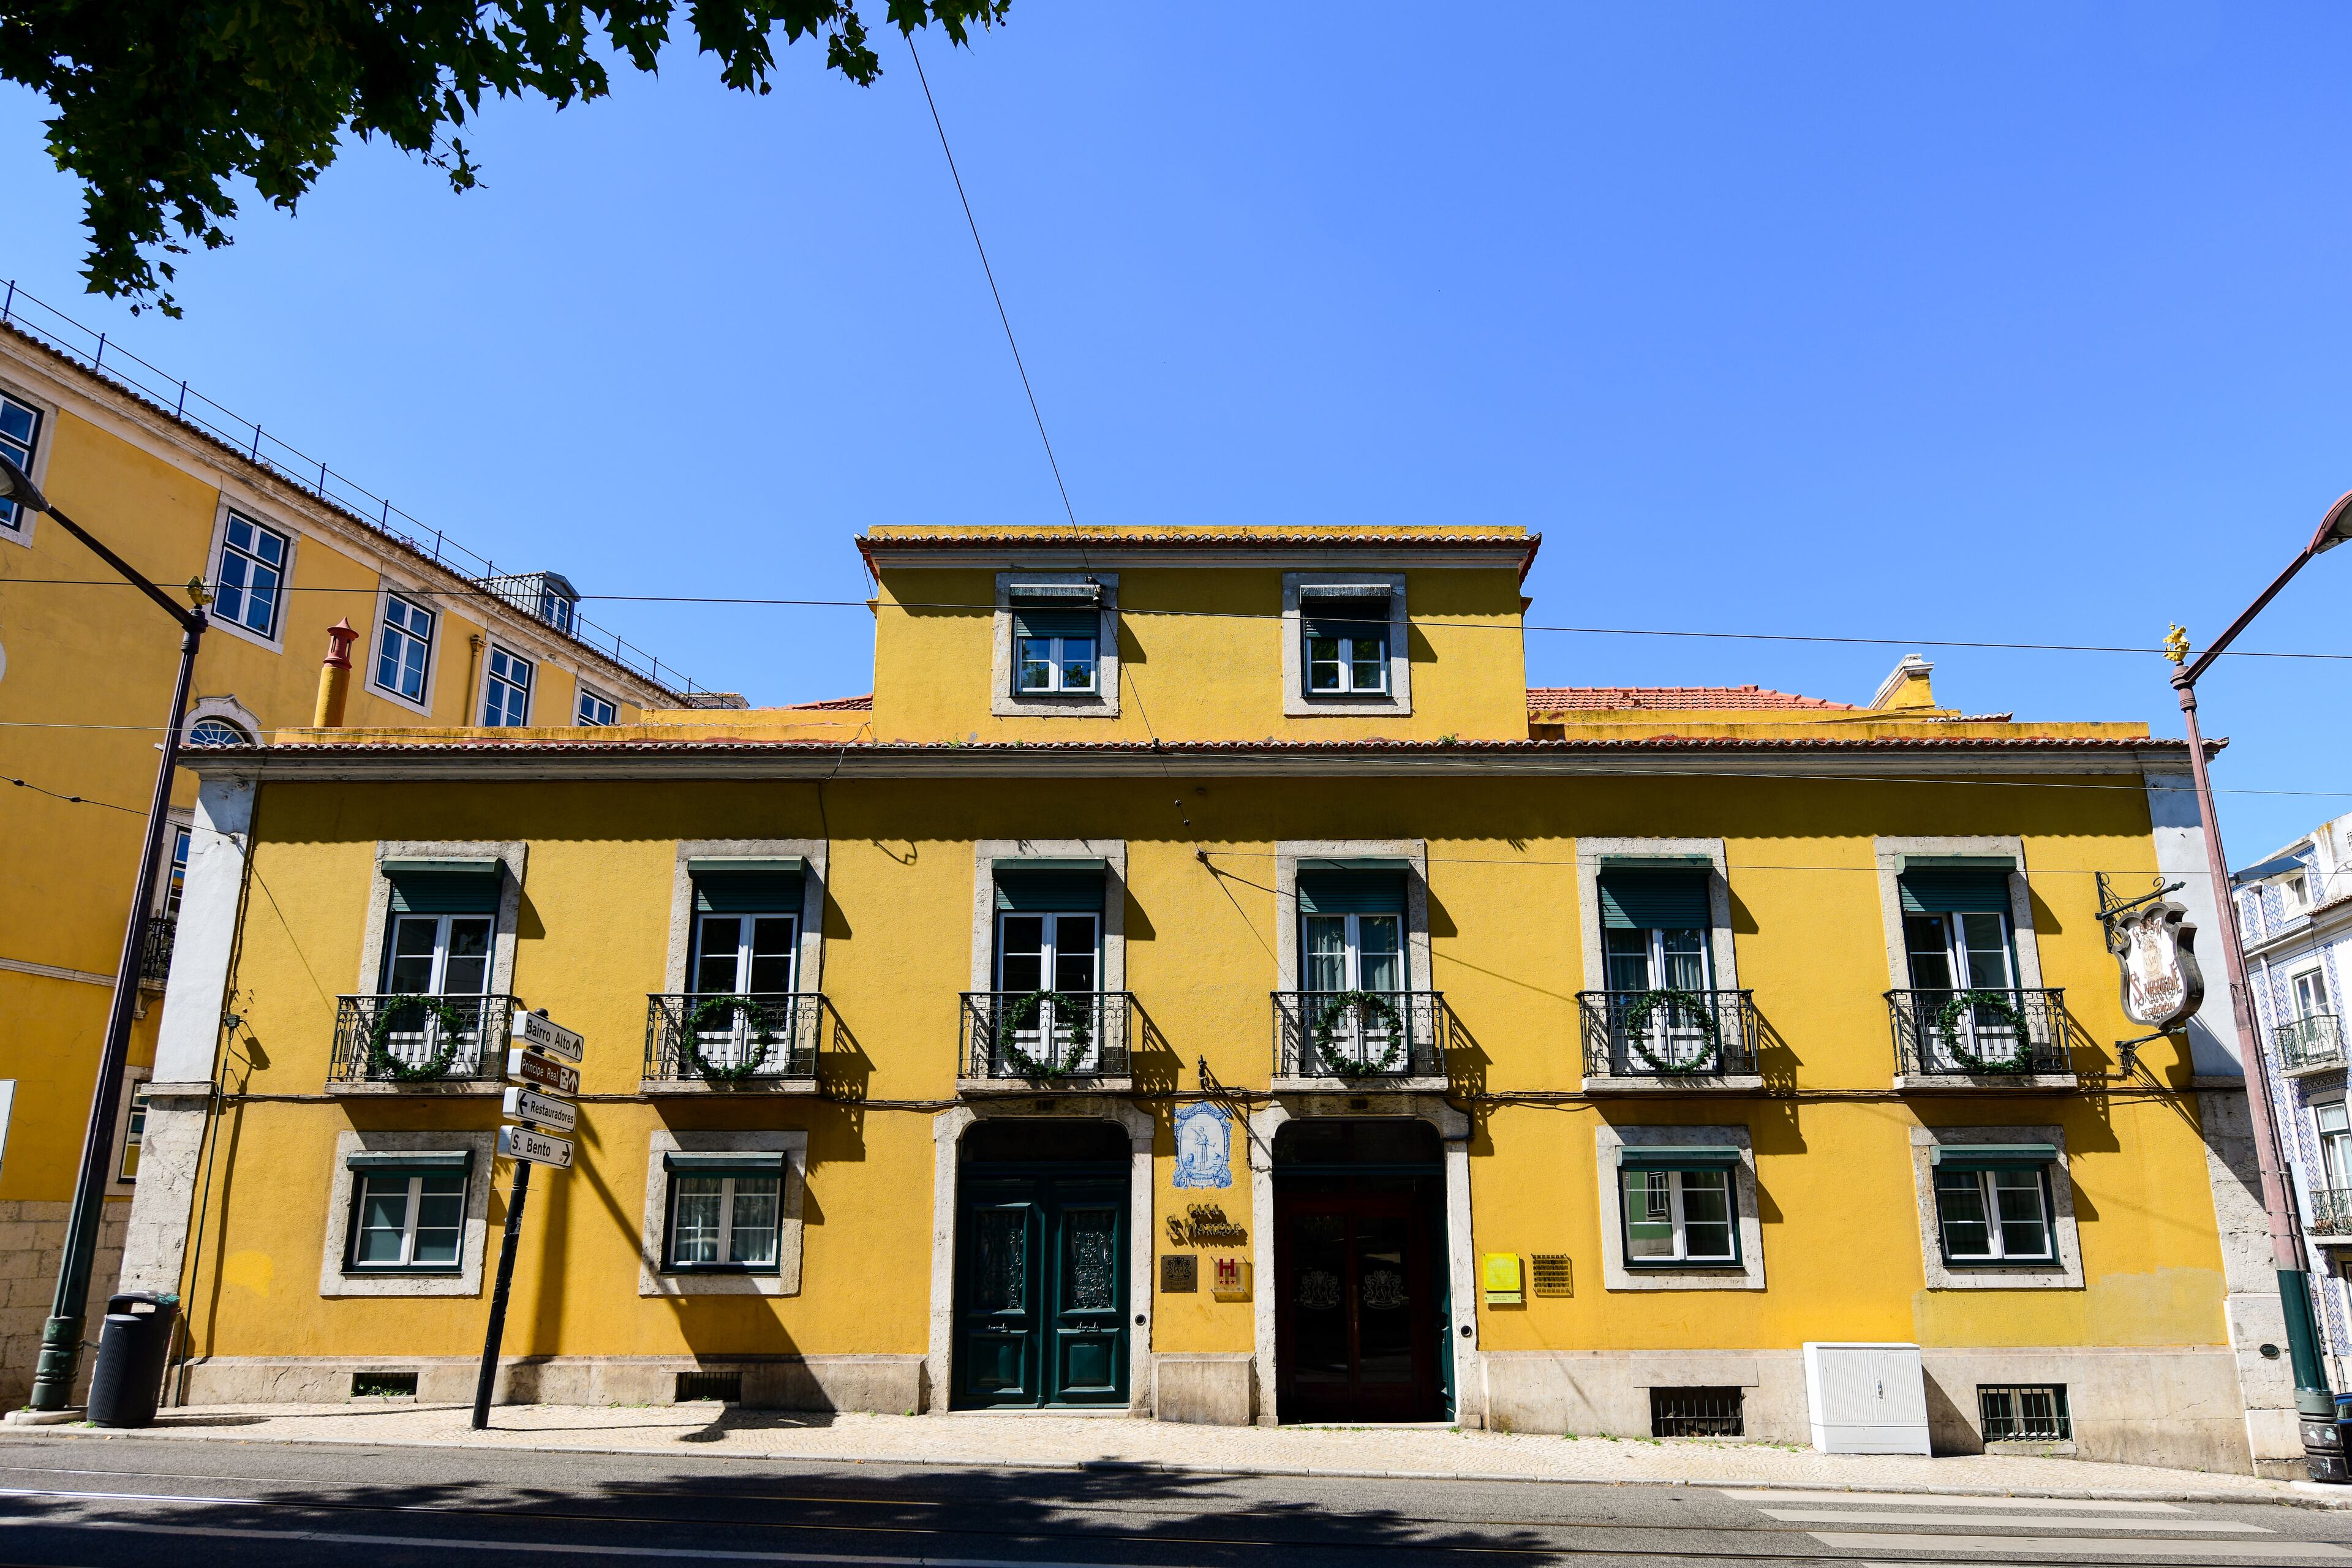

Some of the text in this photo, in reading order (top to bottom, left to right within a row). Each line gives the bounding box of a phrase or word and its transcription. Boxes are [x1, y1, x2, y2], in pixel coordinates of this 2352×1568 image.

[526, 1019, 570, 1051] Bairro Alto
[521, 1058, 559, 1082] Príncipe Real
[530, 1100, 574, 1125] Restauradores
[512, 1134, 551, 1157] S. Bento
[1186, 1203, 1221, 1216] CASA
[1219, 1258, 1235, 1277] H
